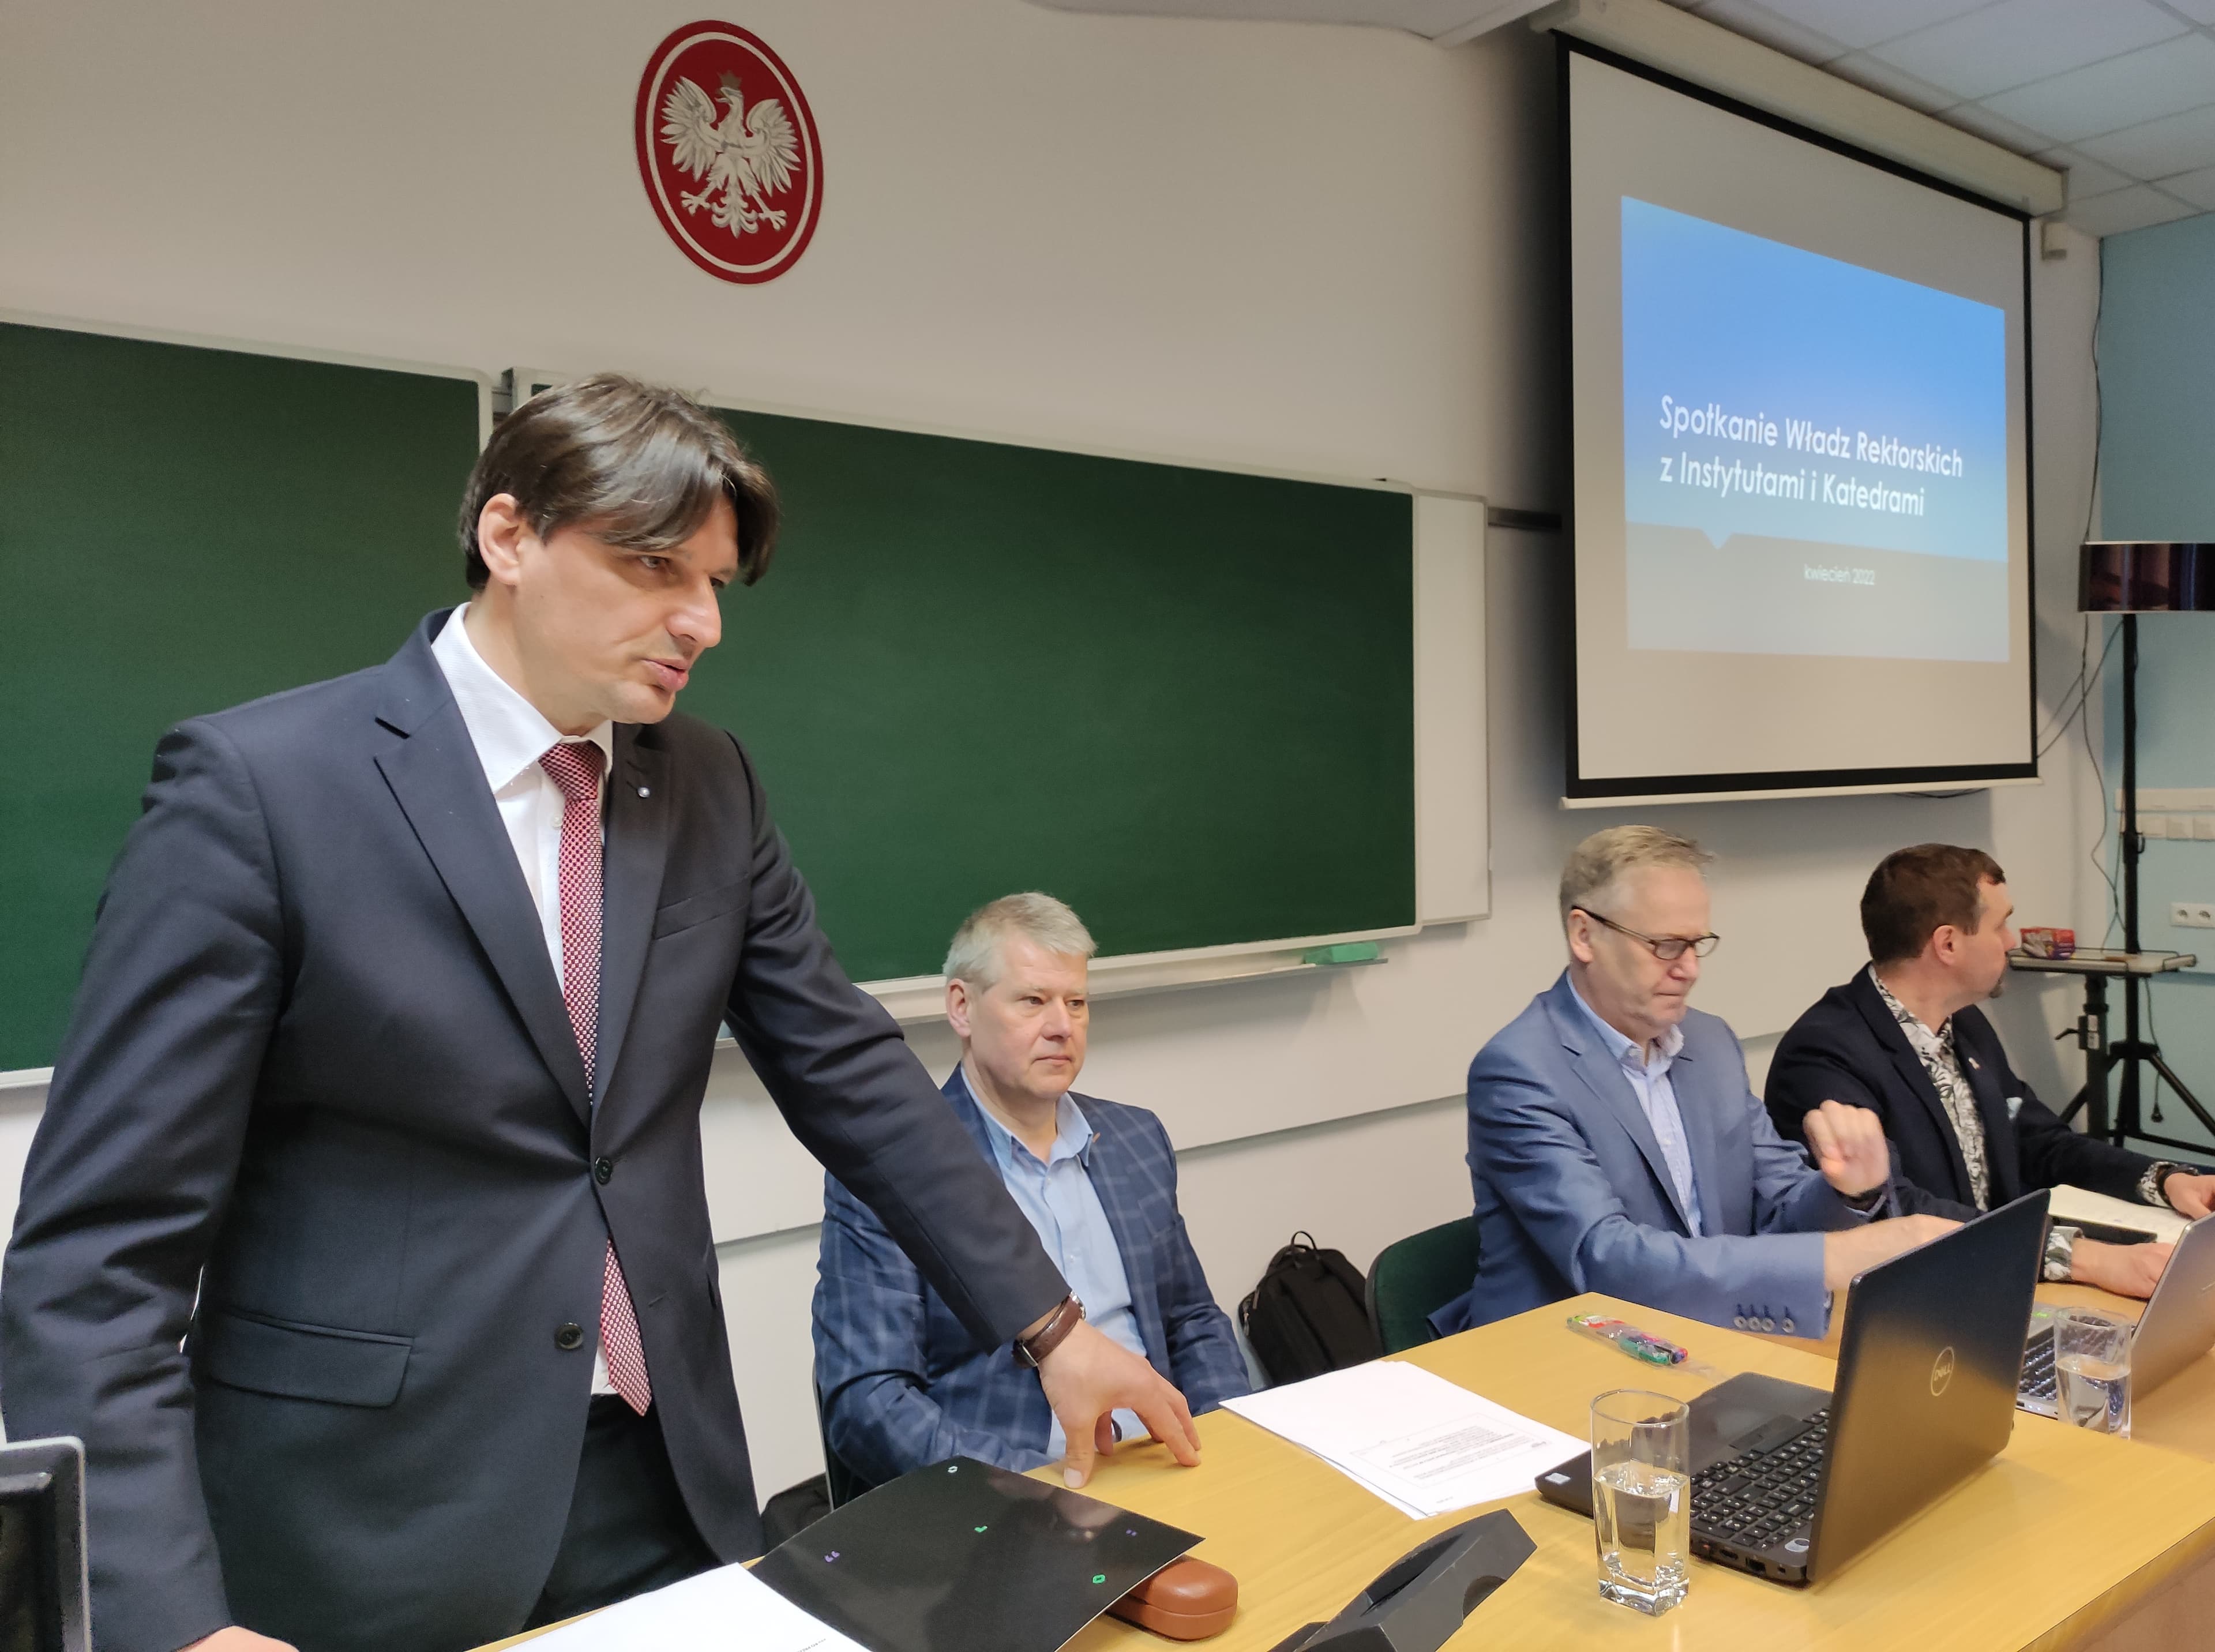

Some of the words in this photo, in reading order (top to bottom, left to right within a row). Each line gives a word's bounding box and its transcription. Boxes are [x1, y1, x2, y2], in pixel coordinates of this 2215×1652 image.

[1660, 395, 1778, 446] Spotkanie
[1785, 418, 1850, 459] Władz
[1856, 431, 1963, 478] Rektorskich
[1660, 456, 1673, 482] z
[1680, 451, 1805, 500] Instytutami
[1811, 470, 1817, 501] i
[1823, 473, 1925, 516] Katedrami
[1804, 564, 1850, 583] kwiecień
[1853, 568, 1875, 585] 2022
[1934, 1362, 1951, 1381] DELL
